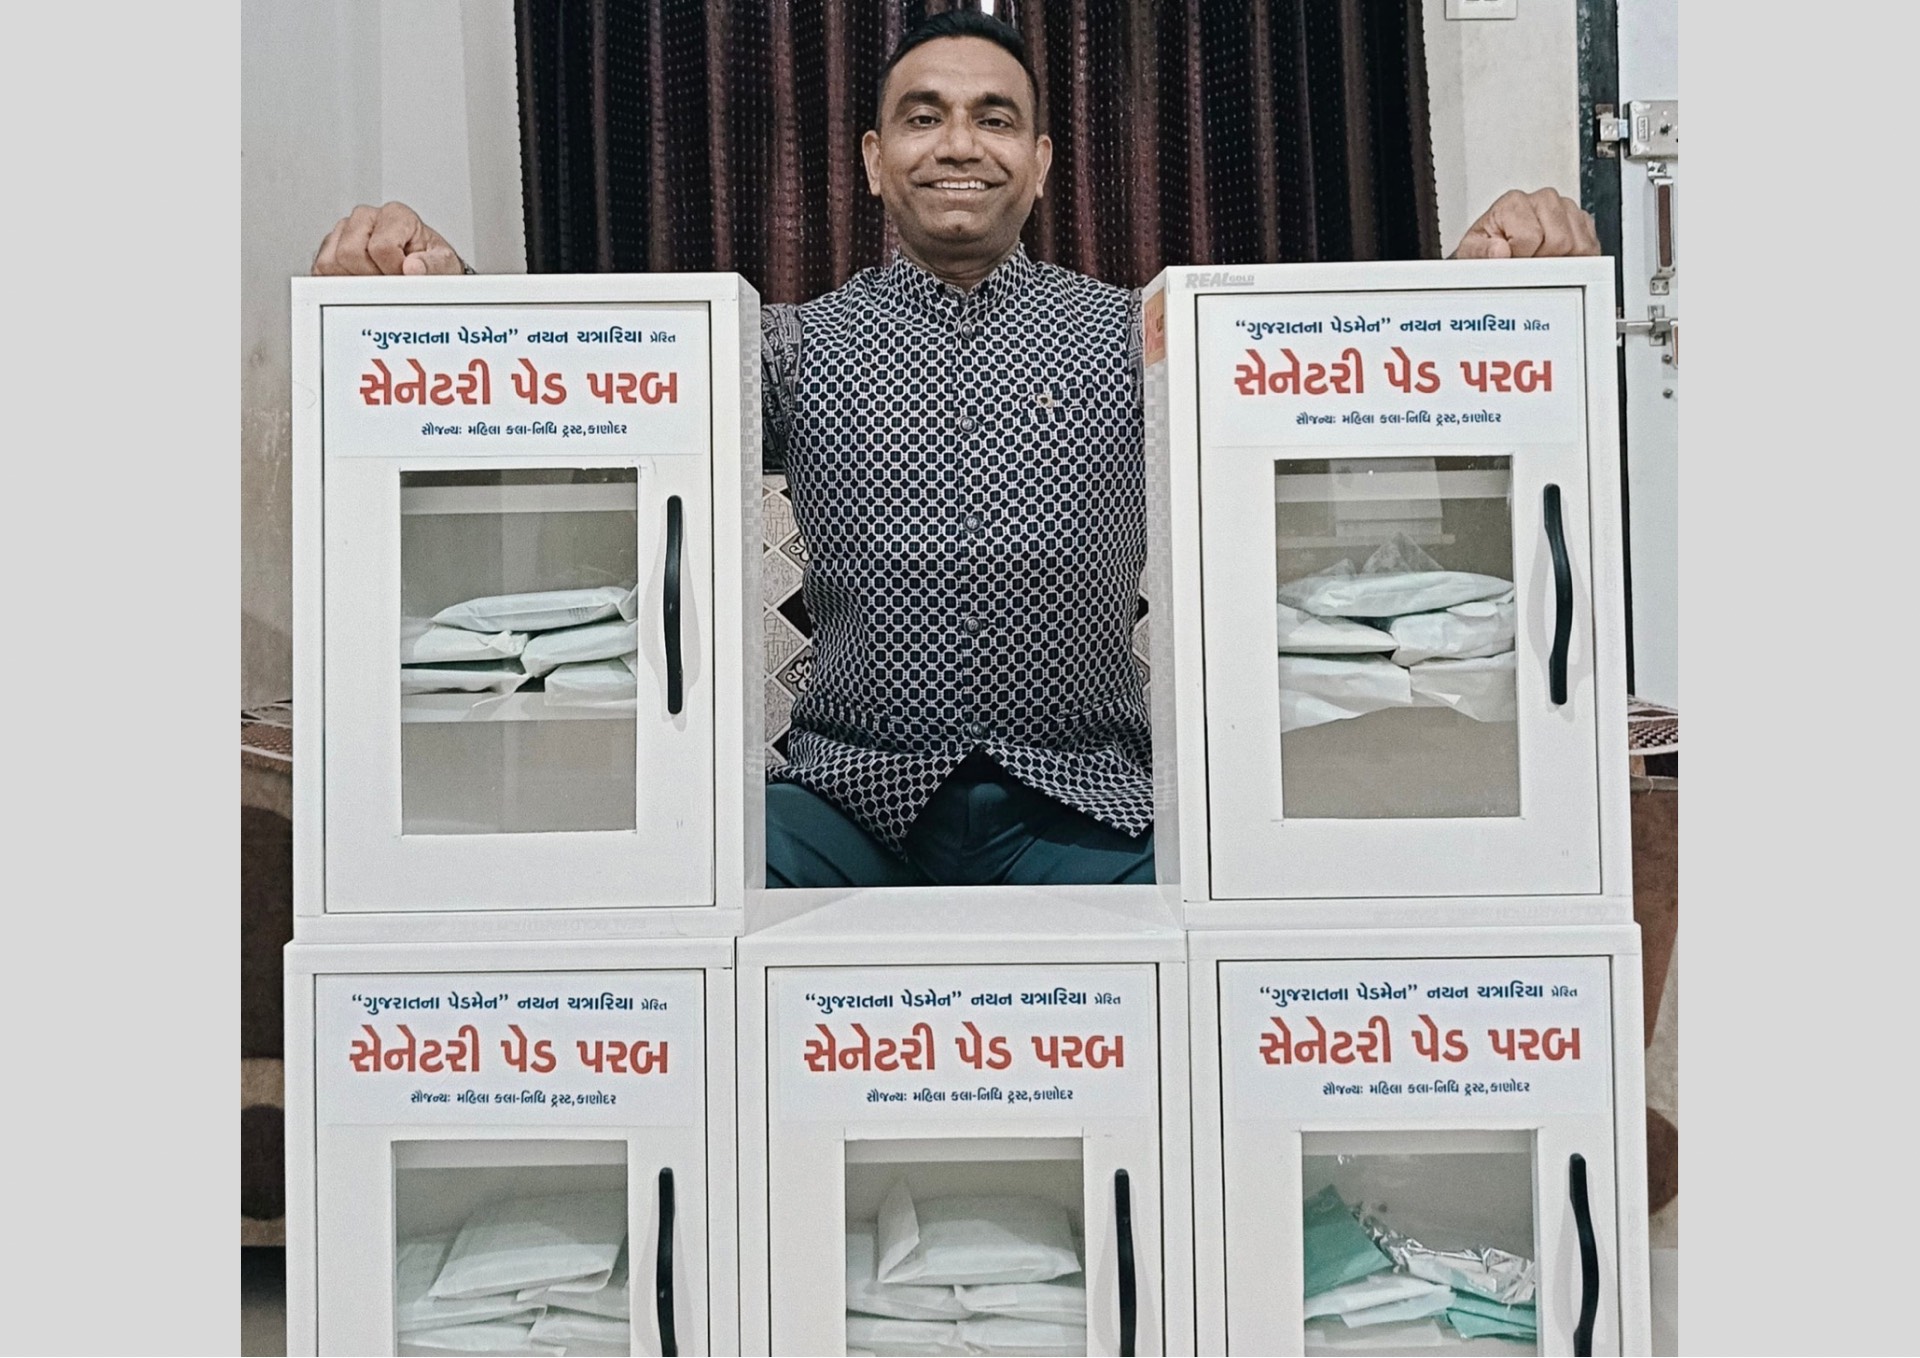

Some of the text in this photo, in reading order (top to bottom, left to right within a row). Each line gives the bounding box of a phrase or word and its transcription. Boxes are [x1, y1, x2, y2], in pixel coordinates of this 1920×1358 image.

[1185, 272, 1255, 289] REAL GOLD
[361, 329, 450, 350] “ગુજરાતના
[458, 326, 519, 344] પેડમેન”
[526, 331, 569, 344] નયન
[649, 331, 676, 343] પ્રેરિત
[1235, 320, 1323, 341] “ગુજરાતના
[1330, 316, 1391, 334] પેડમેન”
[1399, 319, 1442, 333] નયન
[1523, 319, 1550, 331] પ્રેરિત
[360, 358, 677, 405] સેનેટરી પેડ પરબ
[1235, 347, 1552, 395] સેનેટરી પેડ પરબ
[467, 421, 501, 436] મહિલા
[506, 421, 558, 435] કલા-નિધિ
[1342, 410, 1375, 425] મહિલા
[1379, 410, 1431, 424] કલા-નિધિ
[351, 994, 440, 1015] “ગુજરાતના
[447, 991, 508, 1010] પેડમેન”
[516, 996, 559, 1010] નયન
[641, 998, 668, 1011] પ્રેરિત
[805, 993, 894, 1014] “ગુજરાતના
[900, 988, 962, 1008] પેડમેન”
[970, 993, 1013, 1007] નયન
[1094, 992, 1121, 1005] પ્રેરિત
[1259, 986, 1349, 1008] “ગુજરાતના
[1355, 982, 1417, 1000] પેડમેન”
[1426, 986, 1469, 999] નયન
[1551, 985, 1578, 997] પ્રેરિત
[349, 1025, 669, 1074] સેનેટરી પેડ પરબ
[804, 1022, 1124, 1072] સેનેટરી પેડ પરબ
[1259, 1015, 1581, 1065] સેનેટરી પેડ પરબ
[456, 1089, 490, 1104] મહિલા
[494, 1089, 546, 1104] કલા-નિધિ
[912, 1087, 946, 1103] મહિલા
[950, 1086, 1003, 1102] કલા-નિધિ
[1369, 1080, 1403, 1095] મહિલા
[1407, 1079, 1460, 1094] કલા-નિધિ
